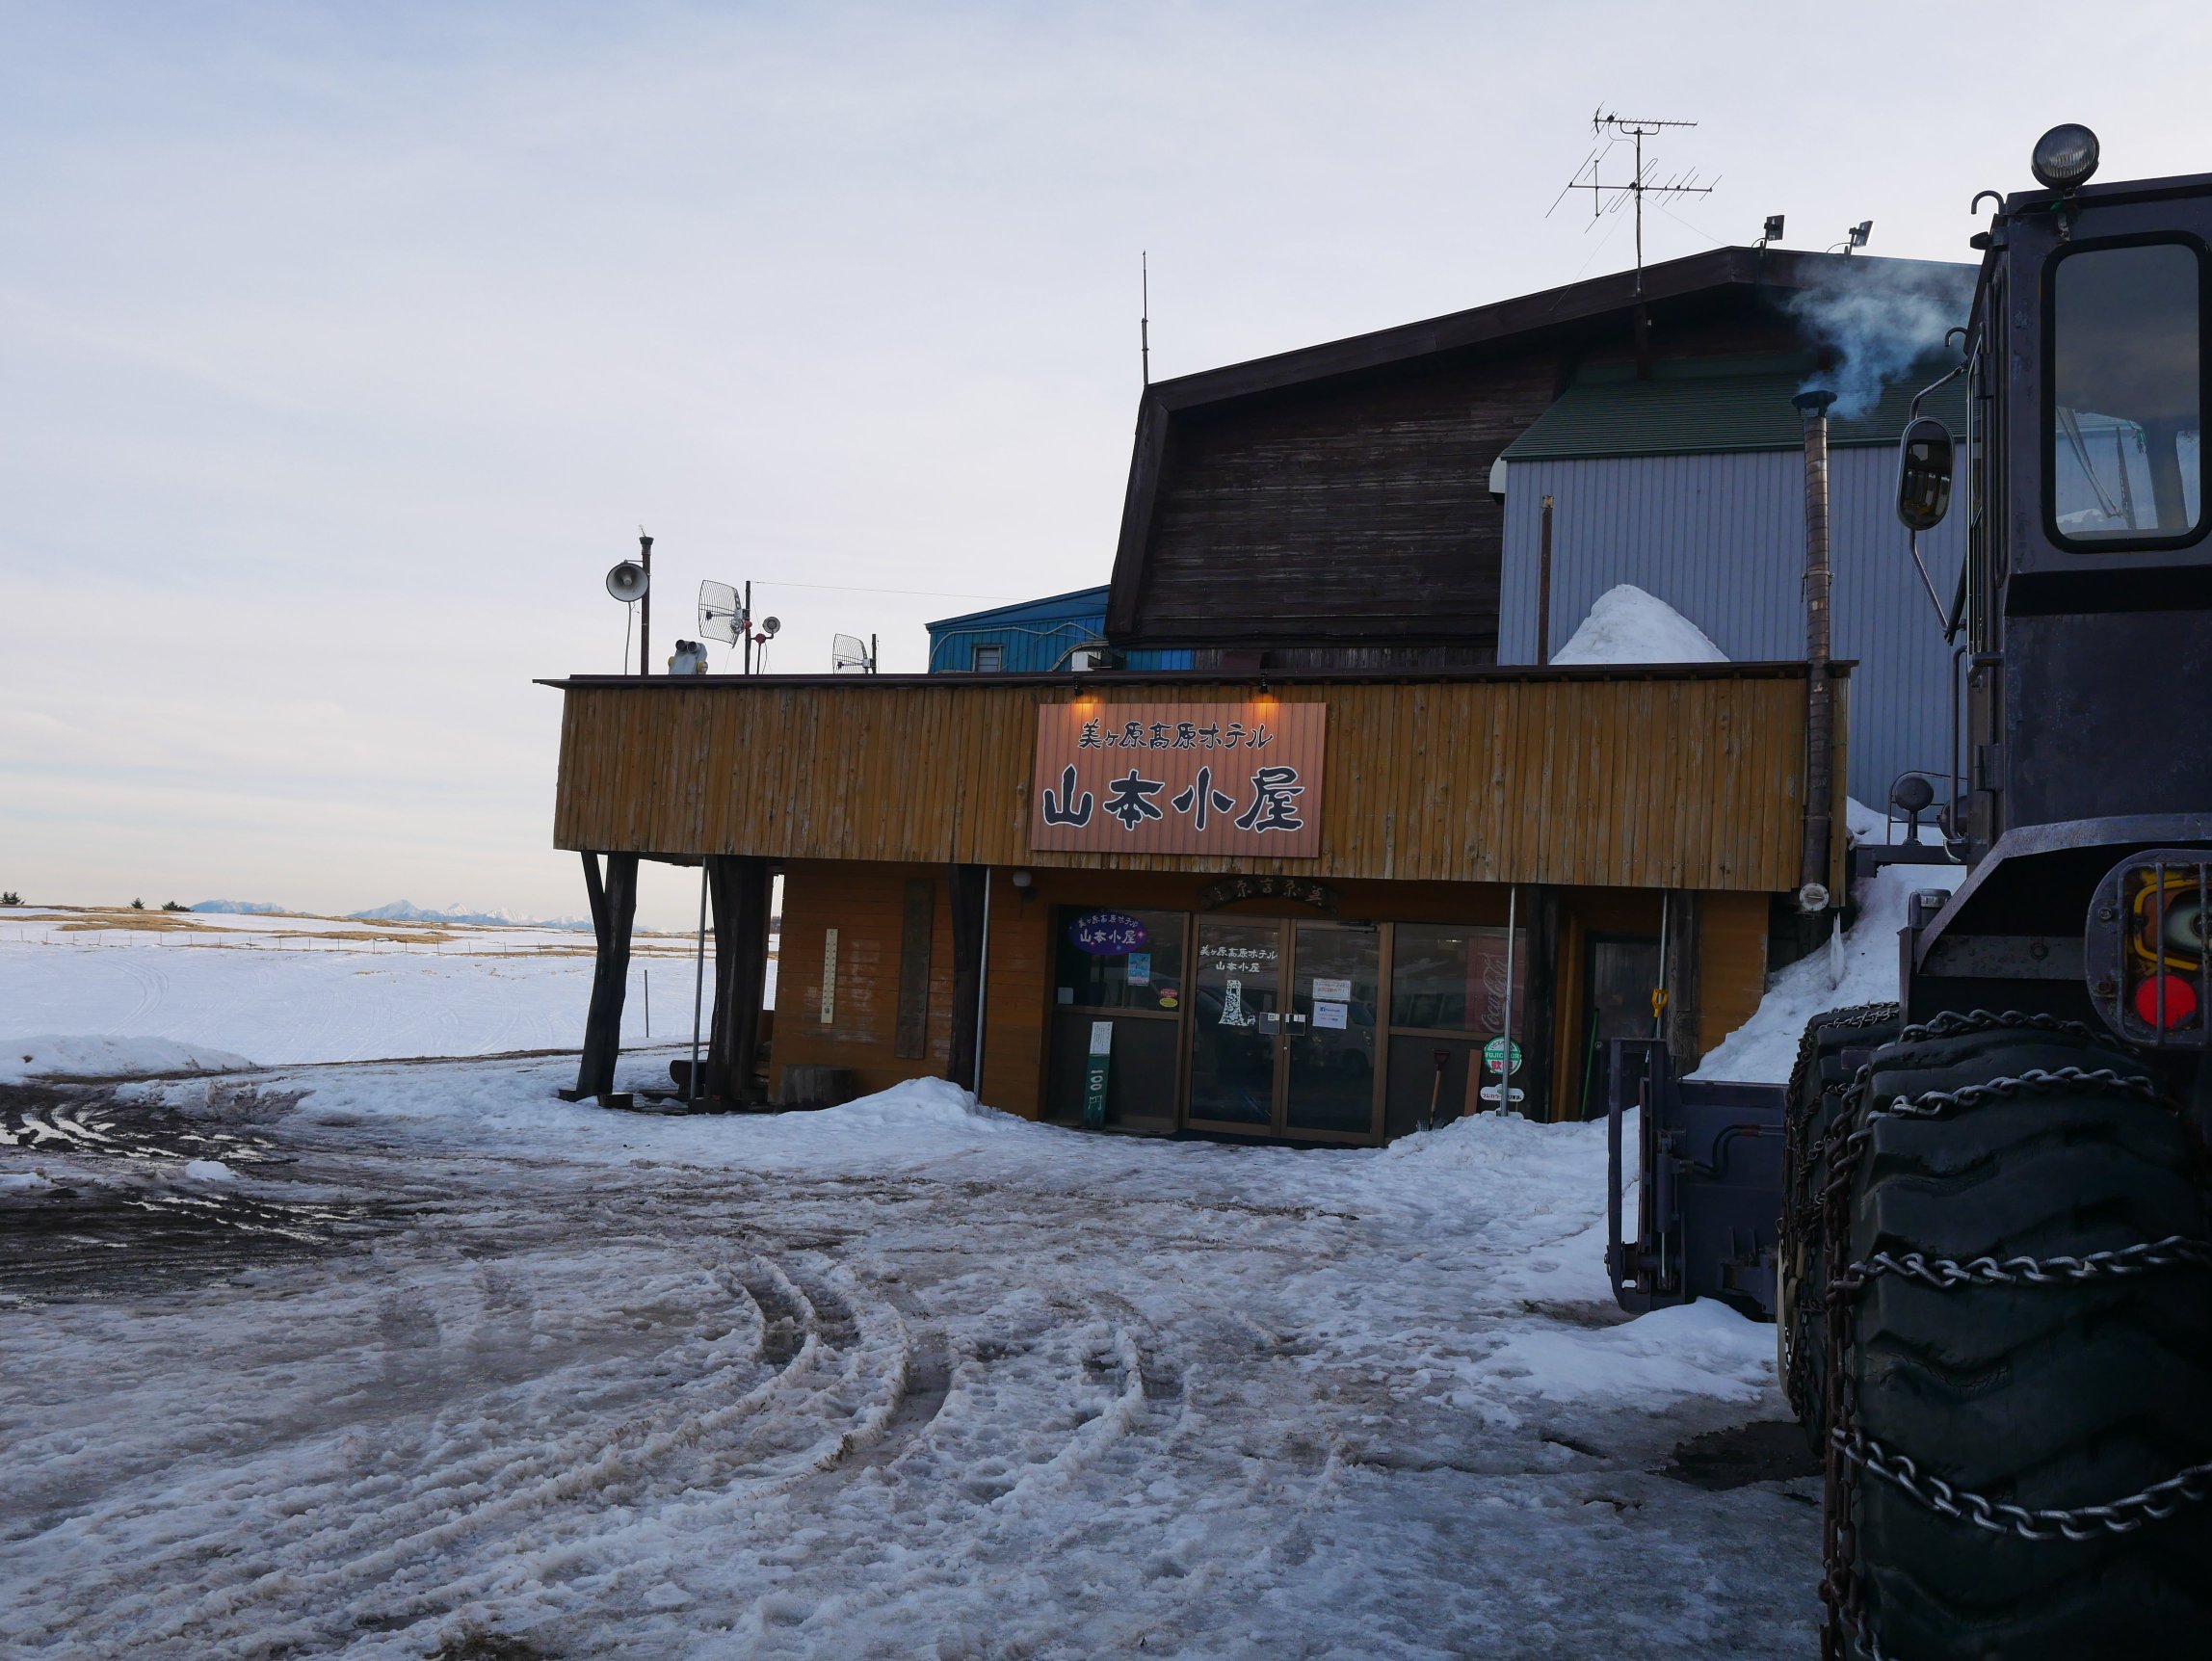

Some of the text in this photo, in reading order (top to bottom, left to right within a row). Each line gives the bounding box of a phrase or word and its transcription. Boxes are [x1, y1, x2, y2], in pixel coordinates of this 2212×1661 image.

[1042, 763, 1305, 834] 山本小屋
[1080, 929, 1136, 944] 山本小屋
[1216, 961, 1260, 973] 山本小屋
